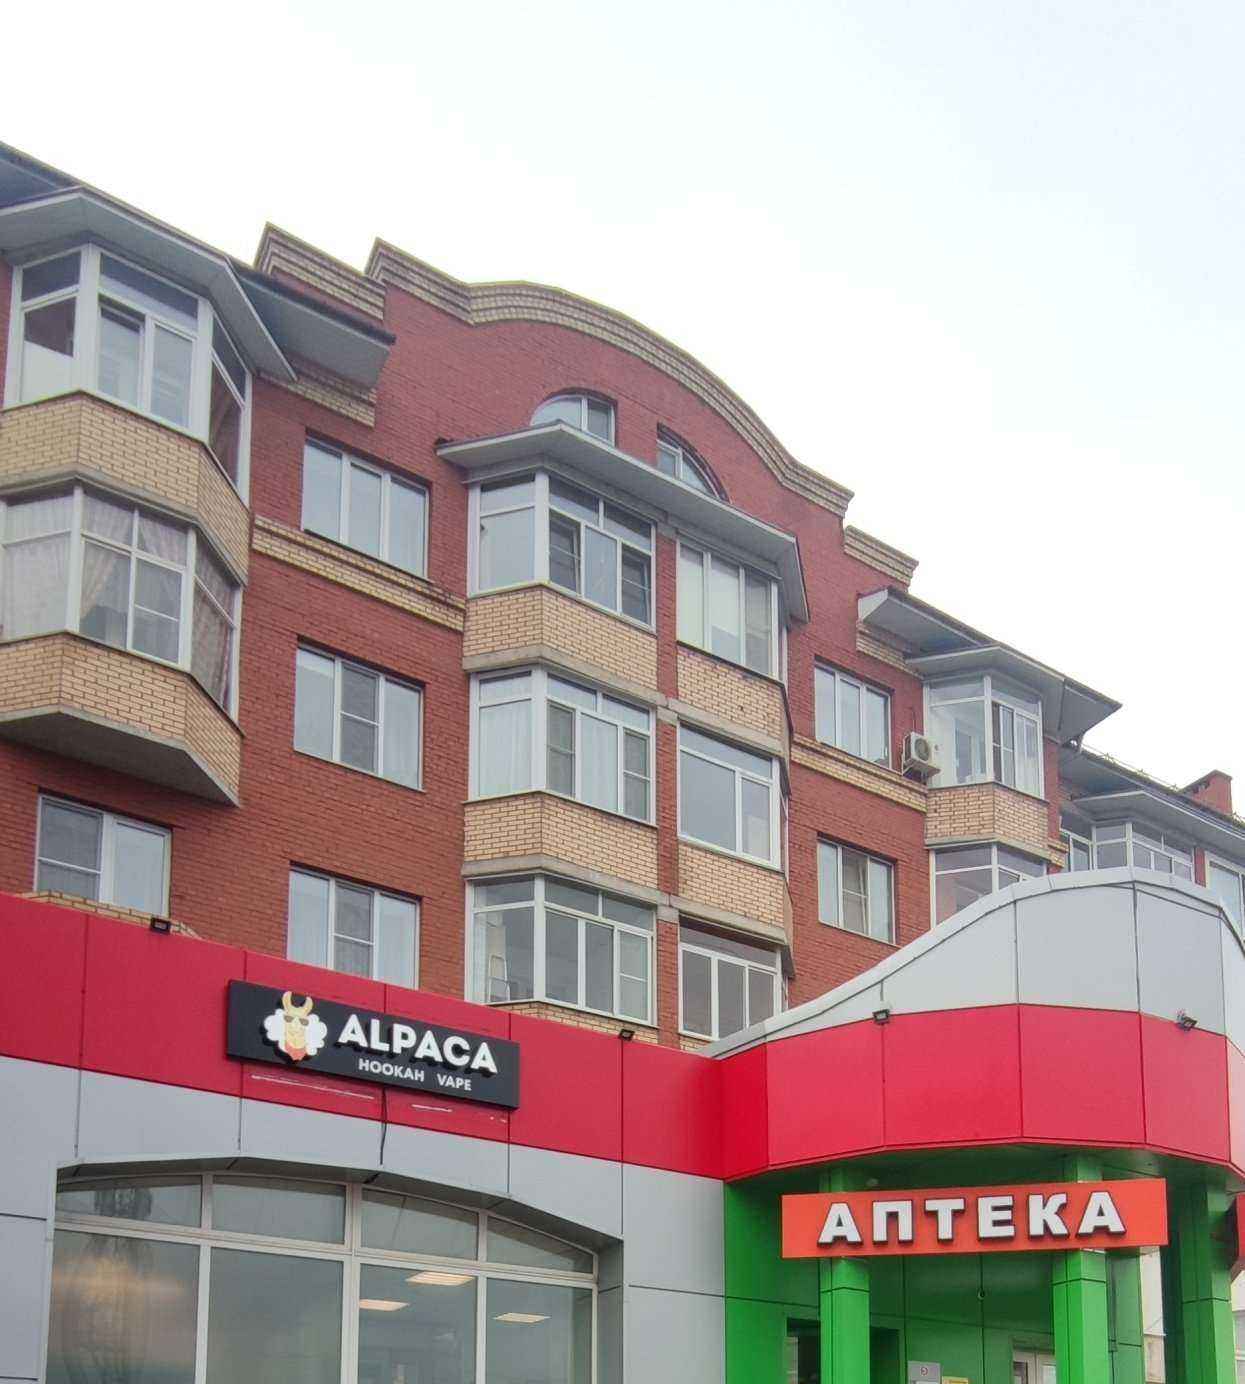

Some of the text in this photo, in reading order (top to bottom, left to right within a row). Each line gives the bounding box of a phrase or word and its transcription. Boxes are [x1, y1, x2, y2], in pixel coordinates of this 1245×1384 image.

[337, 1014, 498, 1074] ALPACA
[358, 1058, 472, 1092] HOOKAH VAPE
[817, 1191, 1127, 1247] АПТЕКА
